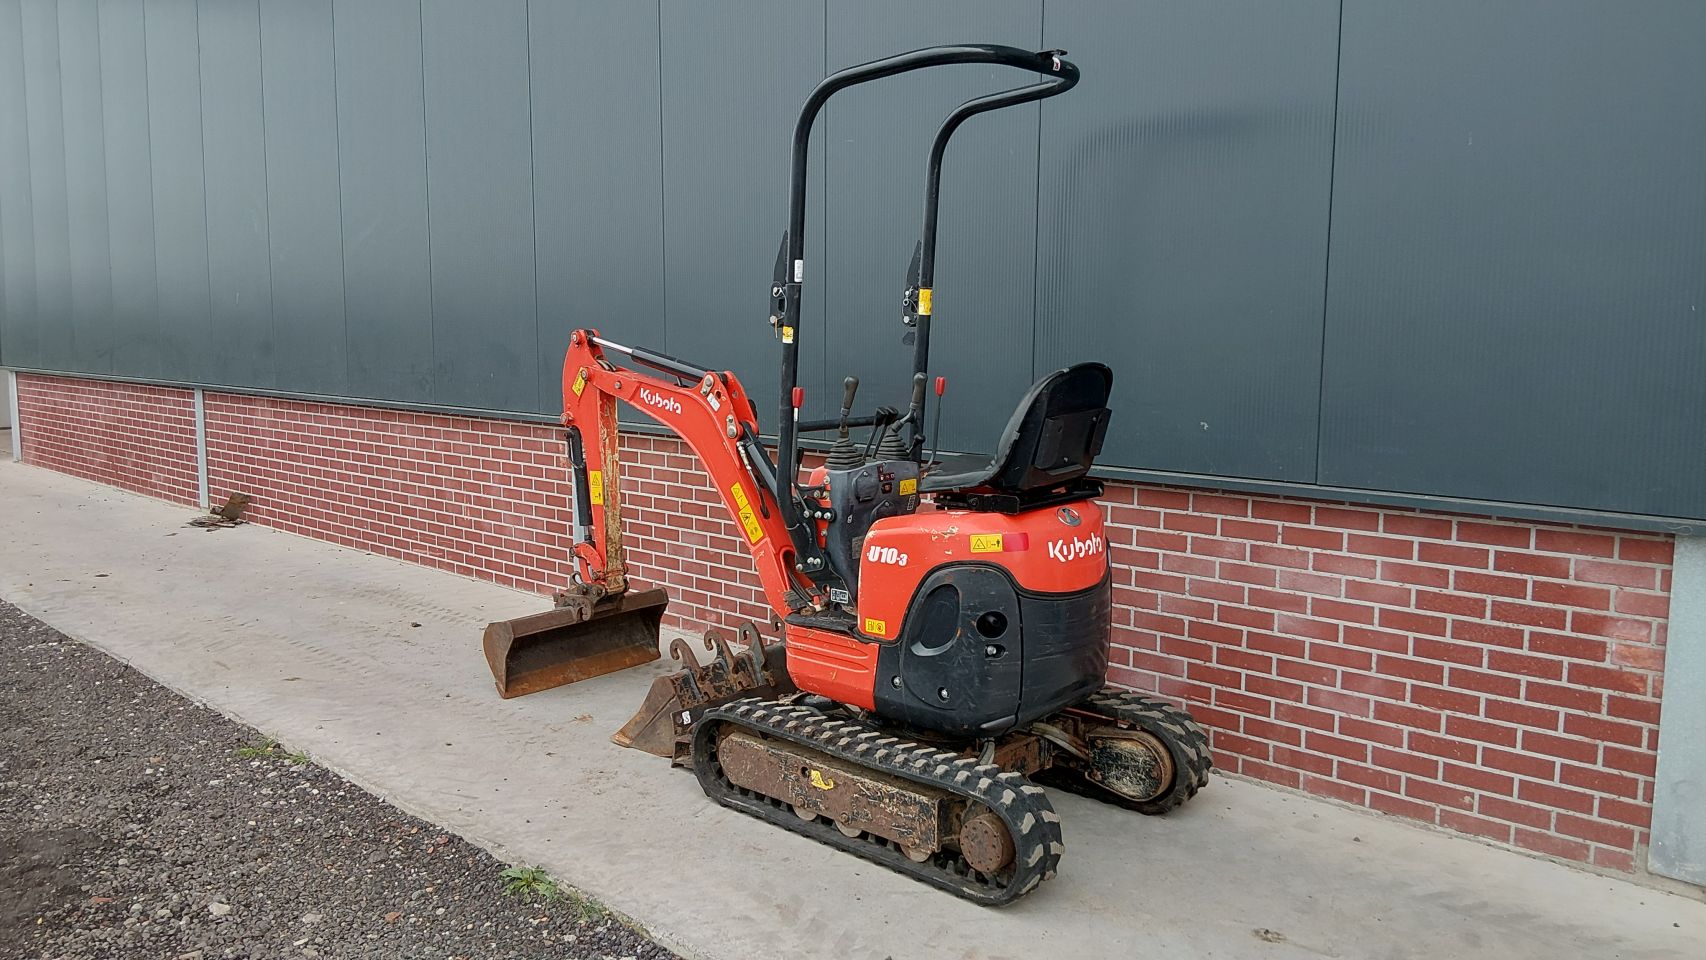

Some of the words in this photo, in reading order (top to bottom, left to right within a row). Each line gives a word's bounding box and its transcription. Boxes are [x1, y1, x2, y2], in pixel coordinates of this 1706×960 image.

[640, 387, 682, 415] Kubota
[867, 545, 908, 567] U10-3
[1047, 531, 1102, 563] Kubota
